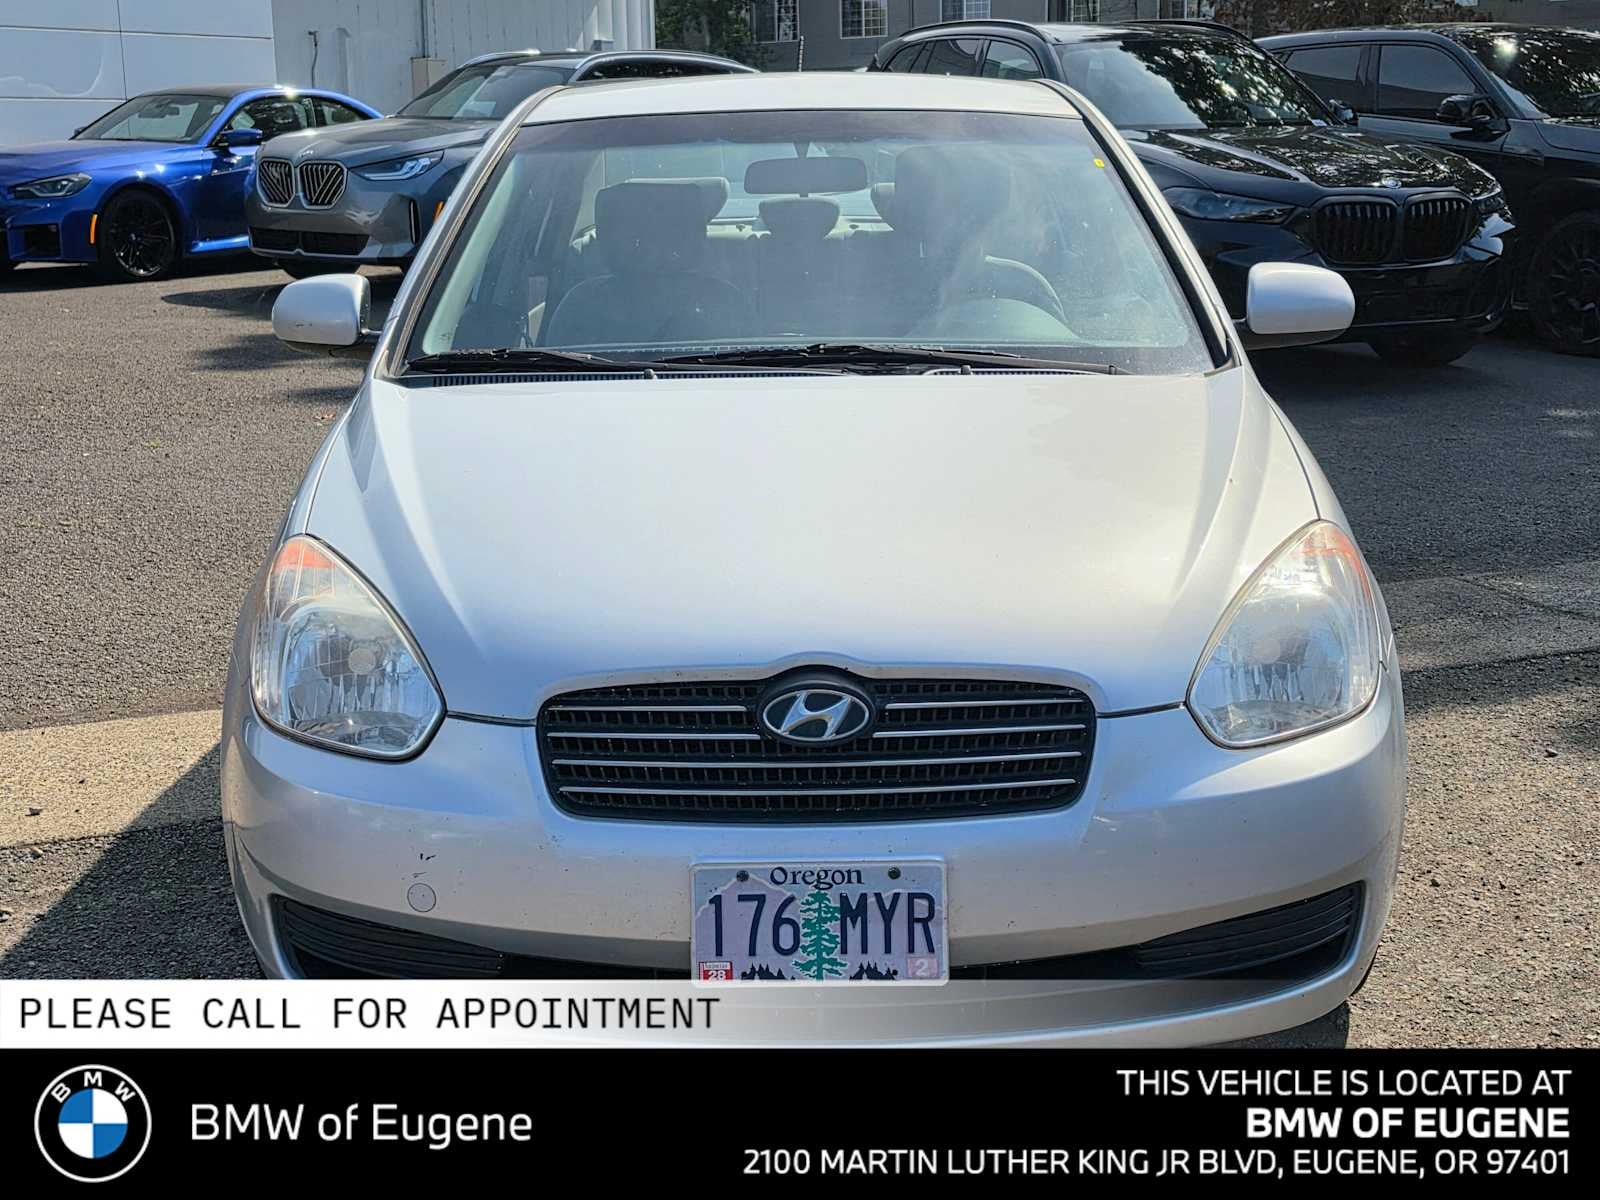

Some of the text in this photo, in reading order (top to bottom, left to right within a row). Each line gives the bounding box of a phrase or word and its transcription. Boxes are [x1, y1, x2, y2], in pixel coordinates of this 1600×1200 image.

[769, 866, 865, 890] Oregon
[708, 892, 936, 957] 176 MYR
[708, 970, 727, 982] 28
